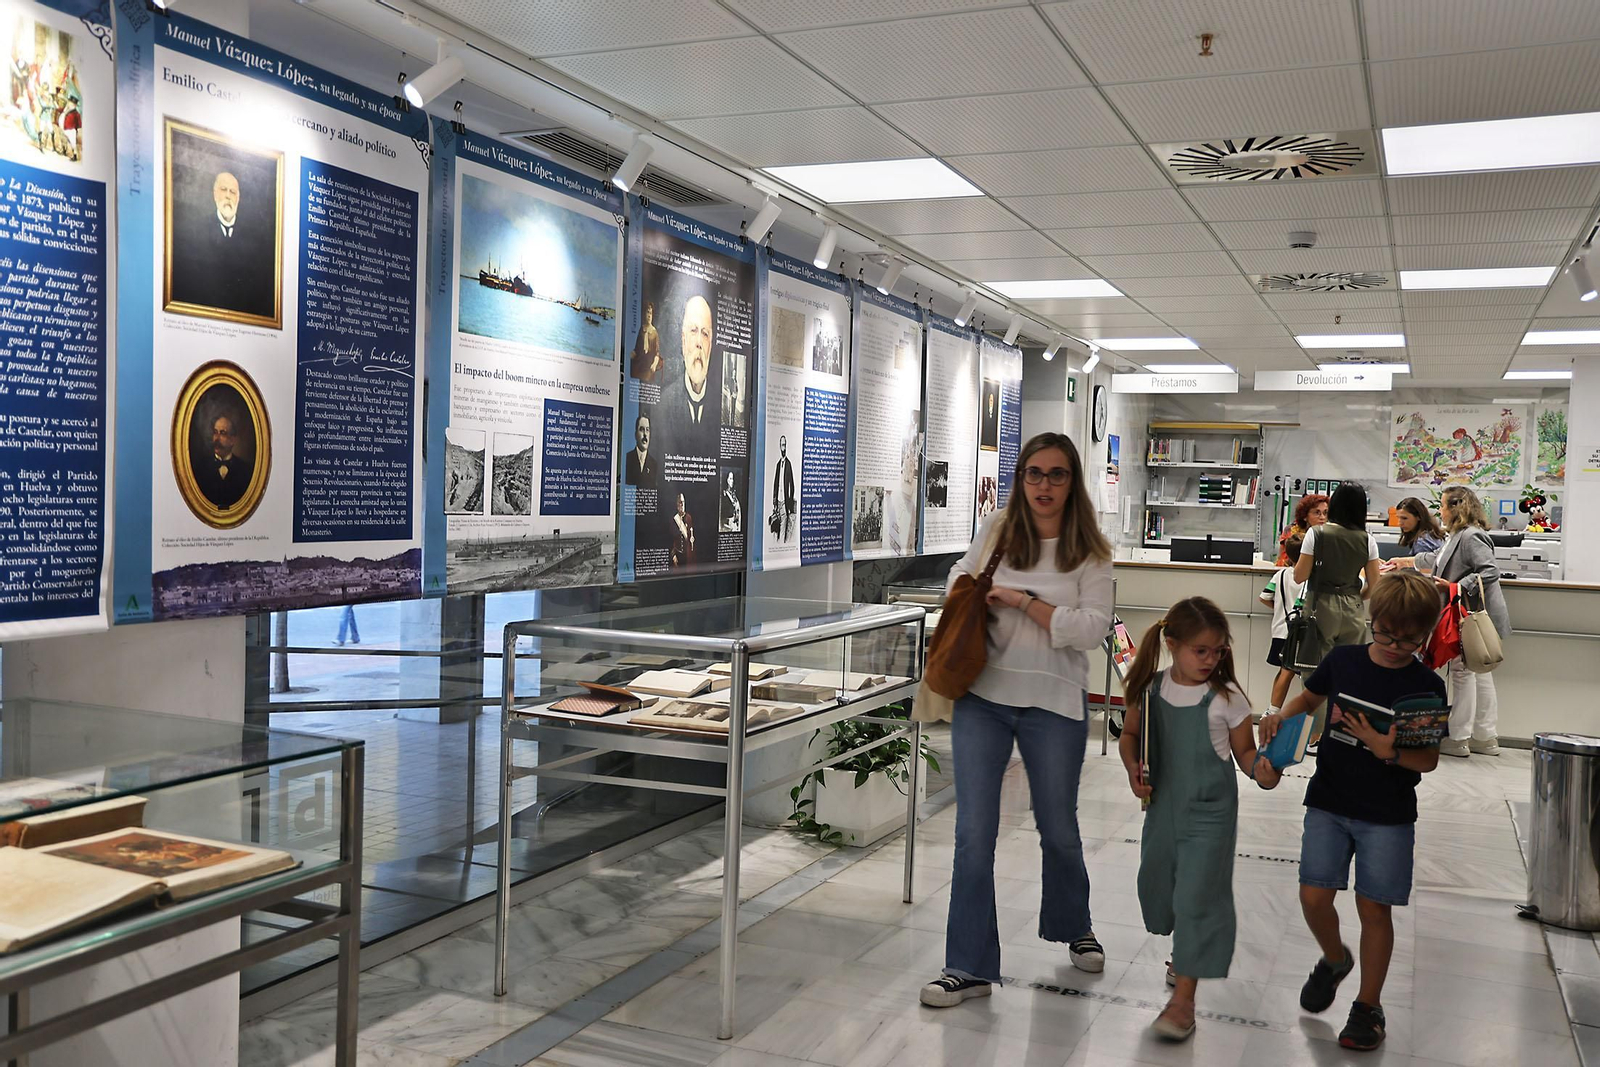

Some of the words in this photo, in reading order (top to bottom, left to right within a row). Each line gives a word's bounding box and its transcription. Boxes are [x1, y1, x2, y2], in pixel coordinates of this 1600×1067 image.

[163, 67, 204, 92] Emilio
[165, 23, 210, 50] Manuel
[216, 36, 273, 72] Vázquez
[277, 61, 317, 90] López,
[319, 83, 330, 94] su
[332, 85, 359, 104] legado
[360, 99, 366, 109] y
[367, 102, 377, 111] su
[378, 103, 401, 121] época
[330, 128, 335, 140] y
[337, 128, 364, 146] aliado
[365, 140, 396, 158] político
[463, 140, 489, 157] Manuel
[492, 146, 527, 171] Vázquez
[529, 161, 555, 181] López,
[8, 180, 21, 191] La
[25, 183, 66, 202] Discusión,
[70, 195, 82, 203] en
[86, 198, 96, 206] su
[308, 172, 316, 182] La
[316, 174, 326, 185] sala
[326, 177, 333, 187] de
[334, 179, 358, 194] reuniones
[359, 187, 365, 196] de
[365, 189, 370, 198] la
[371, 190, 391, 204] Sociedad
[391, 196, 405, 209] Hijos
[405, 200, 410, 209] de
[6, 189, 16, 201] de
[21, 193, 44, 209] 1873,
[48, 199, 80, 217] publica
[84, 210, 96, 219] un
[16, 205, 52, 223] Vázquez
[58, 214, 84, 230] López
[91, 224, 96, 233] y
[307, 204, 326, 216] Emilio
[328, 209, 350, 224] Castelar,
[353, 215, 369, 227] último
[371, 220, 395, 235] presidente
[397, 227, 403, 236] de
[406, 229, 410, 238] la
[8, 218, 19, 228] de
[21, 220, 54, 237] partido,
[56, 229, 67, 237] en
[69, 229, 78, 239] el
[80, 234, 97, 245] que
[12, 230, 40, 243] sólidas
[43, 235, 97, 253] convicciones
[454, 362, 462, 373] El
[463, 364, 492, 379] impacto
[492, 369, 504, 379] del
[504, 370, 524, 382] boom
[525, 375, 547, 386] minero
[556, 378, 561, 388] la
[562, 382, 583, 393] empresa
[584, 384, 610, 395] onubense
[1151, 378, 1197, 388] Préstamos
[1296, 373, 1348, 385] Devolución
[8, 414, 41, 426] postura
[43, 418, 48, 426] y
[61, 416, 88, 426] acercó
[90, 418, 98, 427] al
[5, 425, 16, 434] de
[17, 426, 54, 438] Castelar,
[73, 429, 97, 441] quien
[22, 439, 54, 451] política
[56, 443, 61, 451] y
[62, 440, 98, 452] personal
[303, 456, 313, 464] Las
[315, 456, 331, 465] visitas
[333, 457, 340, 465] de
[342, 458, 363, 466] Castelar
[371, 459, 389, 468] Huelva
[391, 460, 407, 468] fueron
[17, 469, 45, 480] dirigió
[52, 470, 60, 479] el
[67, 470, 97, 480] Partido
[20, 482, 50, 491] Huelva
[56, 485, 62, 493] y
[67, 483, 97, 492] obtuvo
[2, 494, 24, 503] ocho
[27, 494, 73, 506] legislaturas
[76, 495, 97, 504] entre
[18, 506, 84, 518] Posteriormente,
[18, 519, 48, 528] dentro
[50, 519, 63, 528] del
[65, 521, 82, 529] que
[84, 518, 97, 527] fue
[23, 532, 34, 541] las
[38, 530, 84, 542] legislaturas
[87, 530, 97, 539] de
[1196, 1010, 1269, 1028] urno
